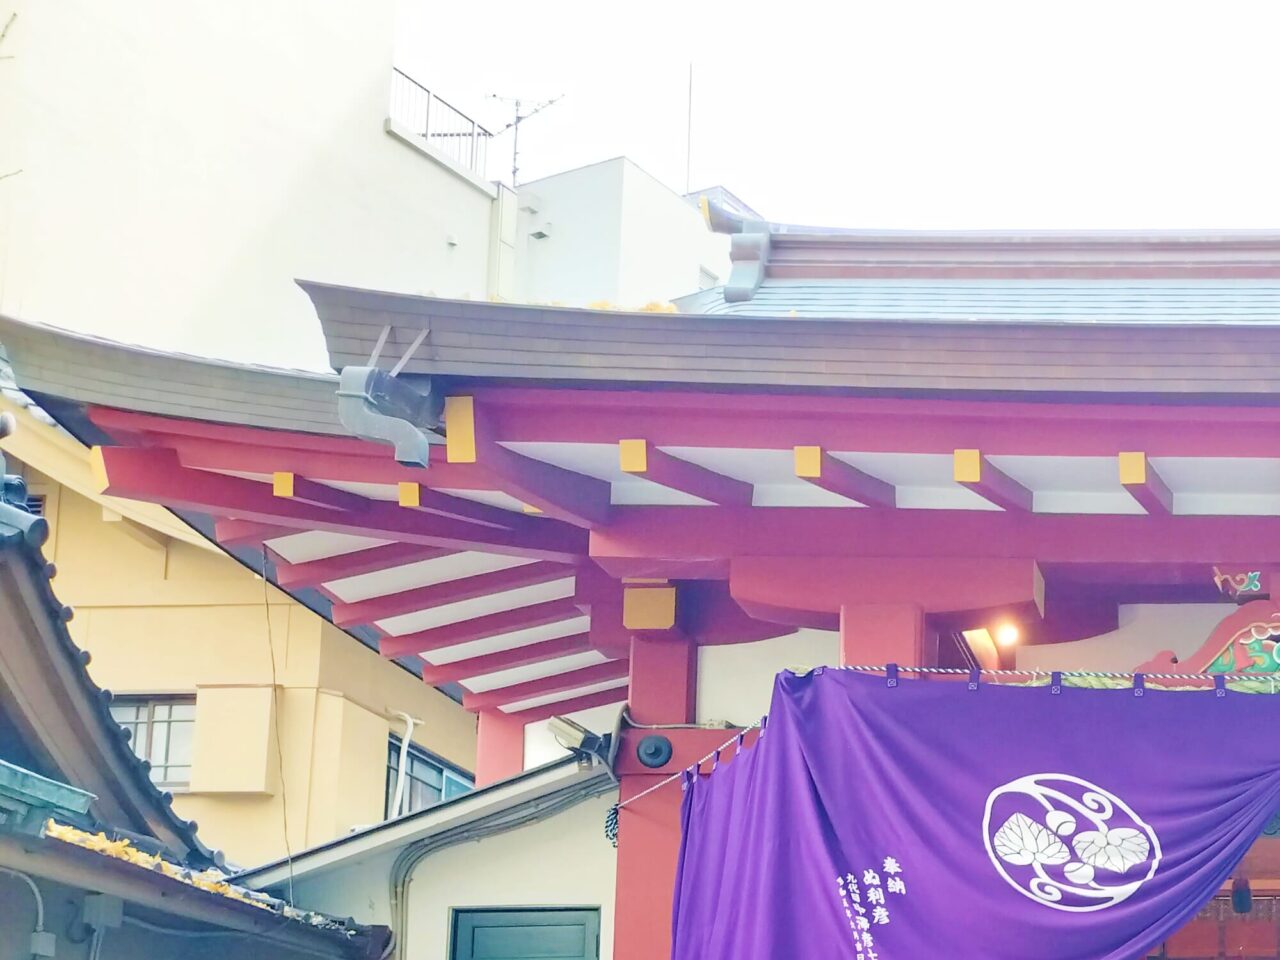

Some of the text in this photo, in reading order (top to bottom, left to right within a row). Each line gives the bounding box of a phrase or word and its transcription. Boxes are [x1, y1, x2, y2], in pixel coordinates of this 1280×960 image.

[863, 868, 890, 925] ぬ利彦
[883, 856, 906, 895] 奉納
